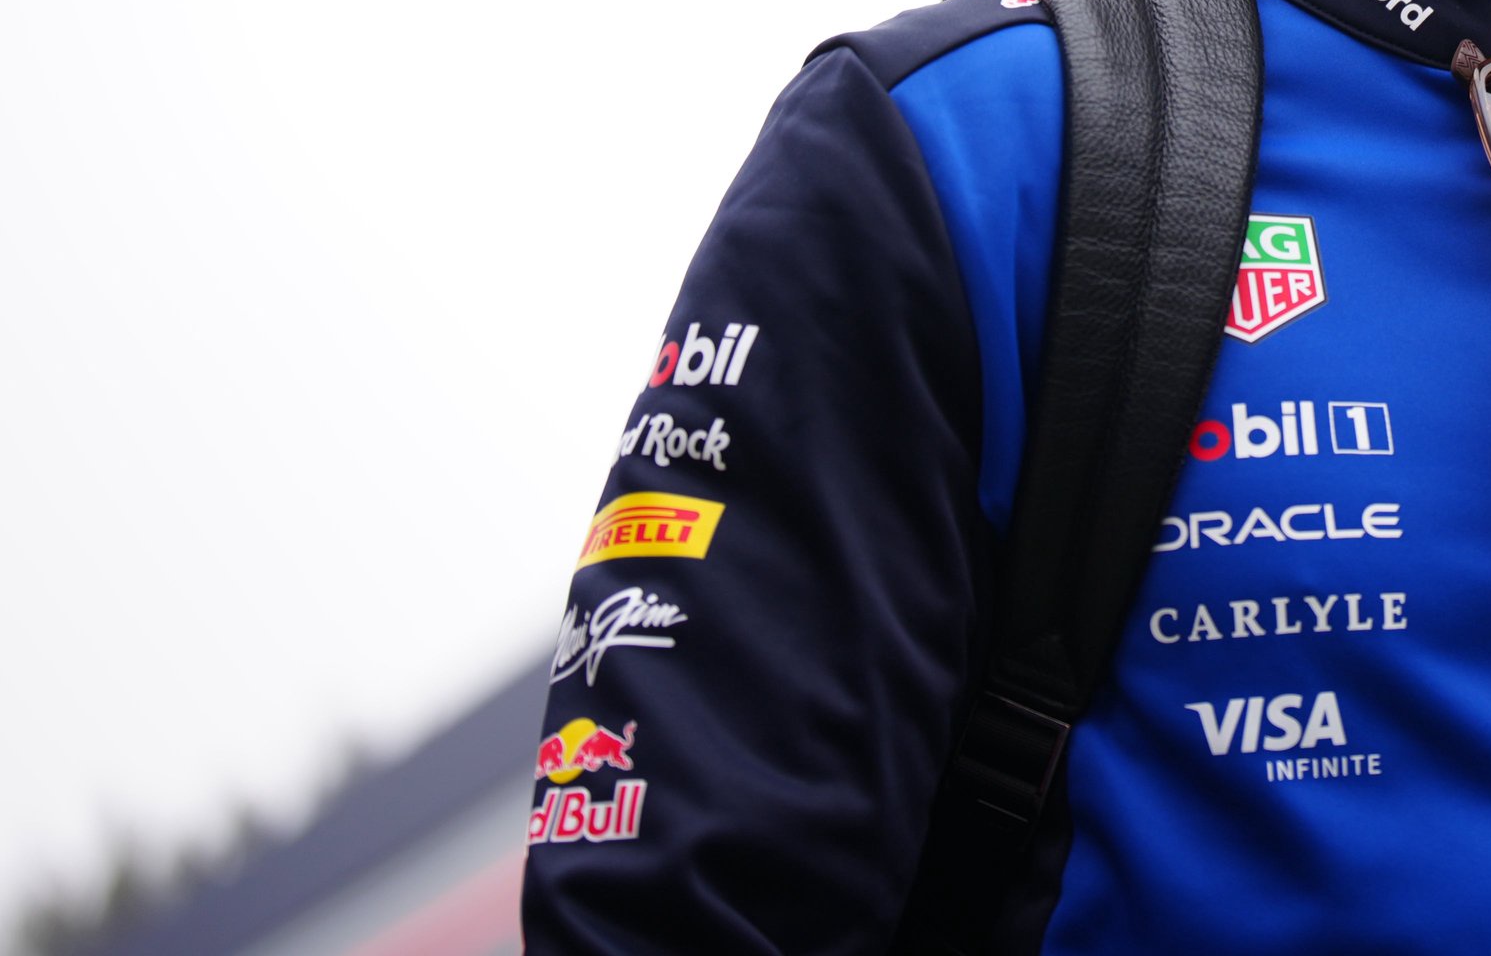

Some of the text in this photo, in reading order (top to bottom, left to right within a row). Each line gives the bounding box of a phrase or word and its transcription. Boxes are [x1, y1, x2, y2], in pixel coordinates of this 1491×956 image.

[1232, 271, 1312, 331] UER
[649, 322, 759, 388] obil
[641, 412, 731, 471] Rock
[1189, 400, 1318, 462] obil
[1150, 592, 1408, 644] CARLYLE
[1184, 691, 1347, 756] VISA
[1266, 754, 1382, 782] INFINITE
